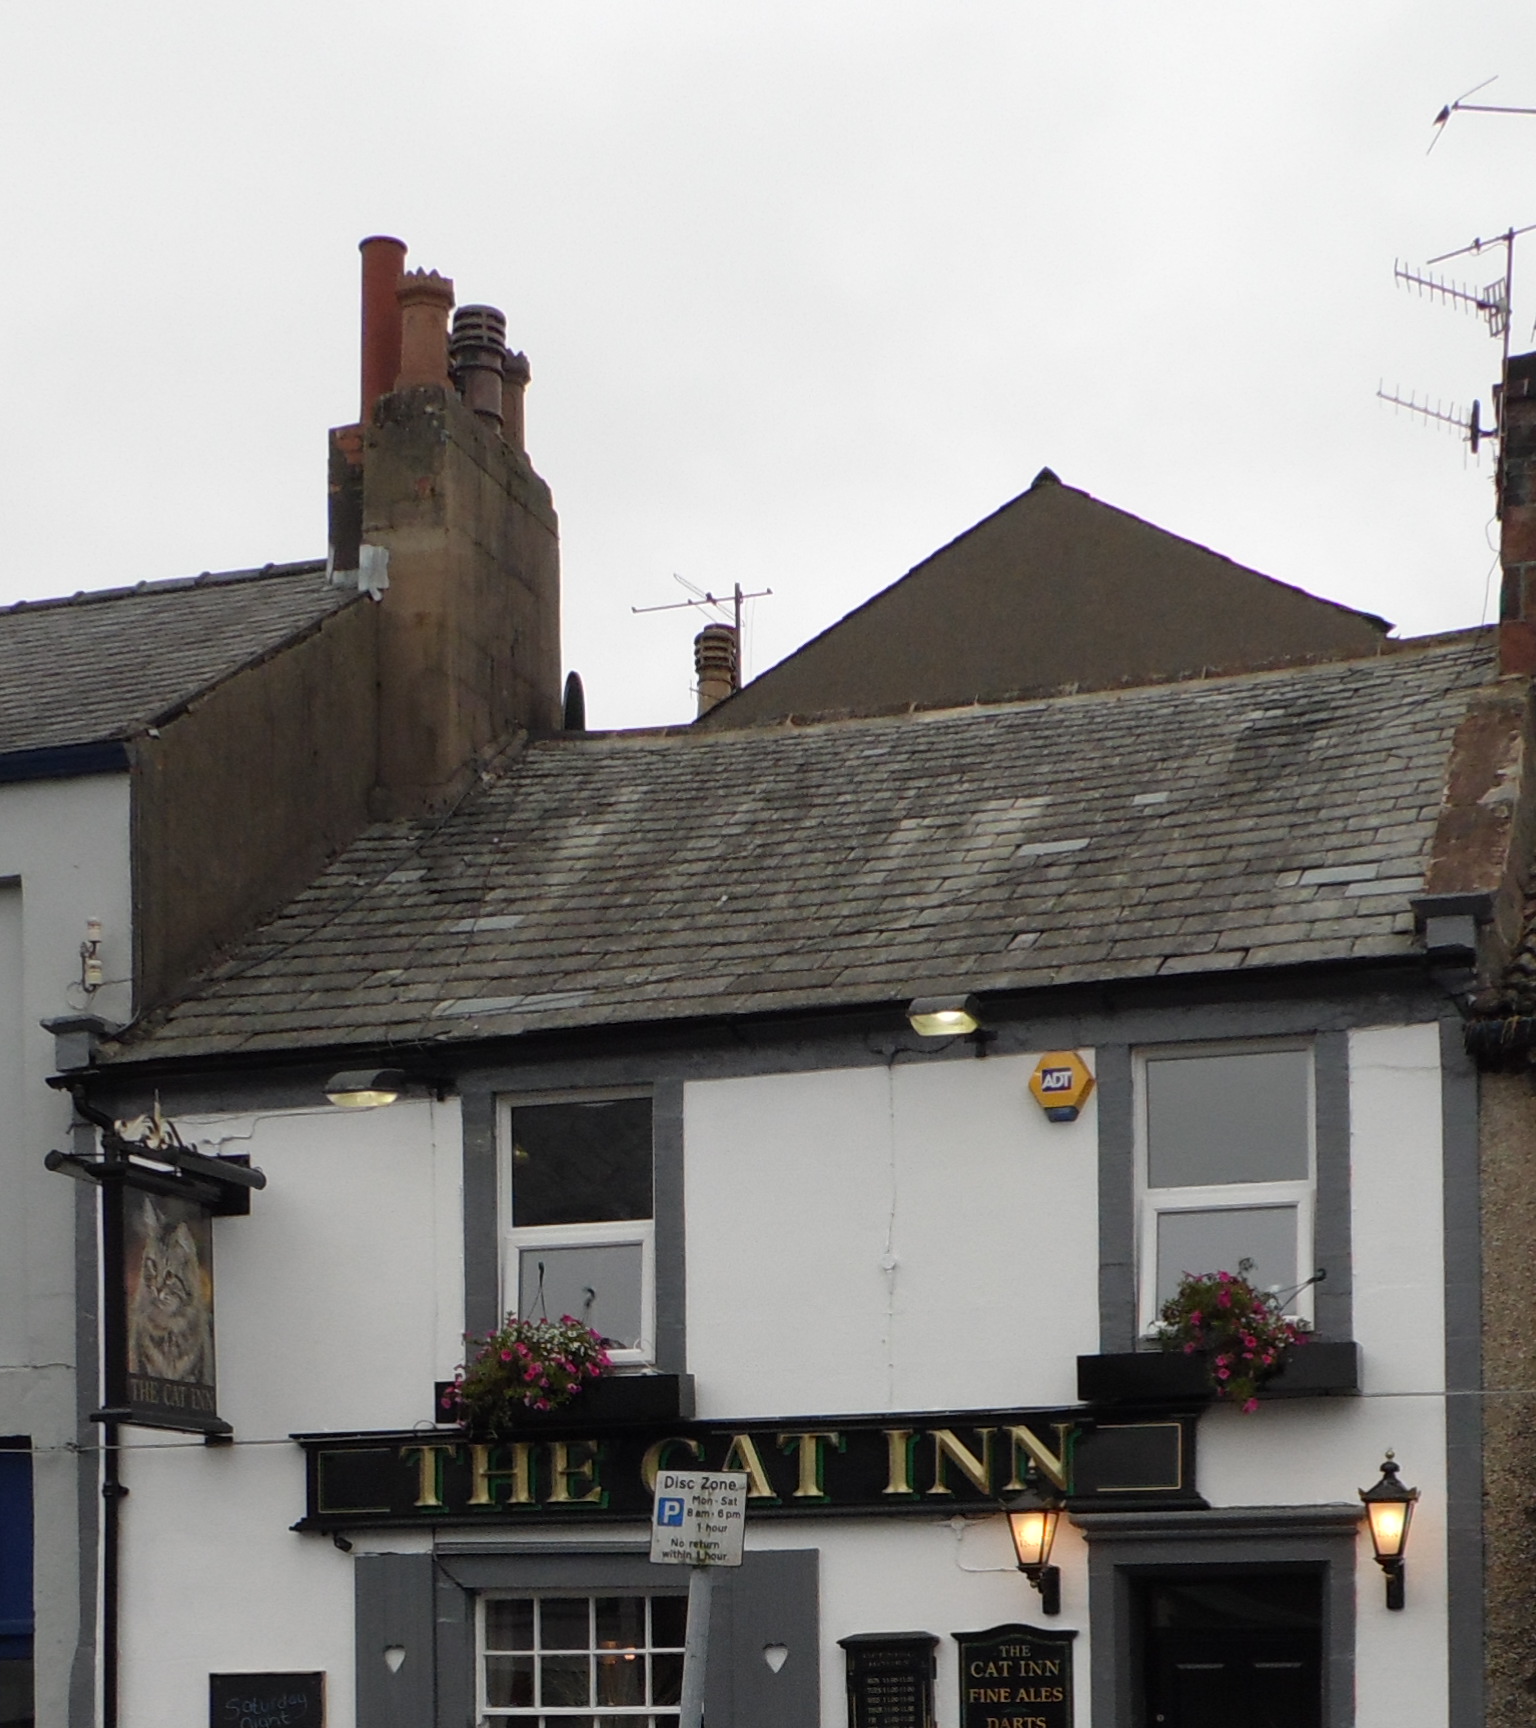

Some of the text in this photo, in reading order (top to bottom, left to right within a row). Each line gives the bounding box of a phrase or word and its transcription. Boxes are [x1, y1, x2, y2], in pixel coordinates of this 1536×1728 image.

[1042, 1070, 1072, 1090] ADT
[129, 1378, 215, 1413] THE CAT INN
[399, 1438, 605, 1508] THE
[881, 1423, 1076, 1496] INN
[664, 1476, 737, 1491] Disc Zone
[692, 1496, 713, 1506] Mon
[721, 1497, 738, 1506] Sat
[663, 1500, 681, 1524] P
[706, 1523, 728, 1533] hour
[670, 1538, 720, 1549] No return
[662, 1549, 692, 1559] within
[704, 1550, 728, 1561] hour
[999, 1645, 1031, 1658] THE
[970, 1660, 1061, 1678] CAT INN
[969, 1687, 1064, 1703] FINE ALES
[224, 1693, 308, 1721] Saturday
